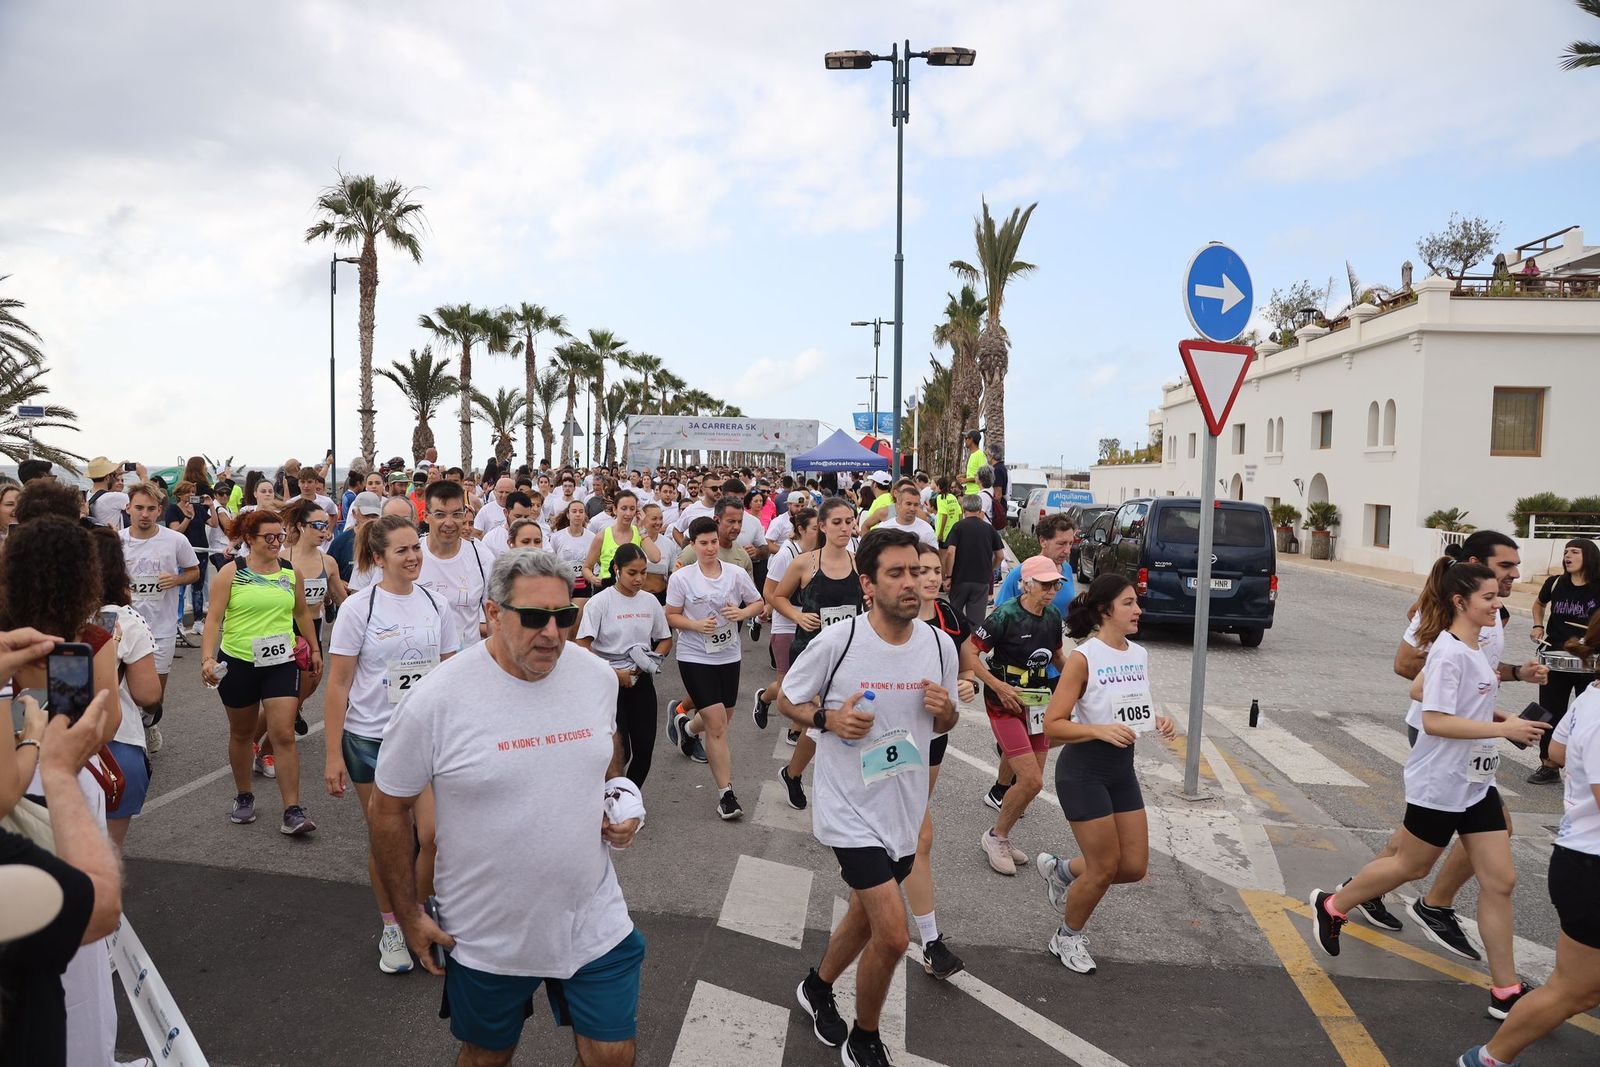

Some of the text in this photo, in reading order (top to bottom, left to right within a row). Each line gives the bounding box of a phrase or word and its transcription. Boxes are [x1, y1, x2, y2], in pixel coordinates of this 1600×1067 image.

[688, 422, 757, 431] 3A CARRERA 5K
[1214, 580, 1229, 588] HNR
[305, 587, 326, 597] 272
[711, 629, 732, 644] 393
[261, 643, 286, 658] 265
[860, 681, 869, 689] NO
[1117, 705, 1151, 722] 1085
[497, 741, 510, 751] NO
[511, 736, 544, 750] KIDNEY.
[545, 734, 556, 745] NO
[886, 745, 898, 763] 8
